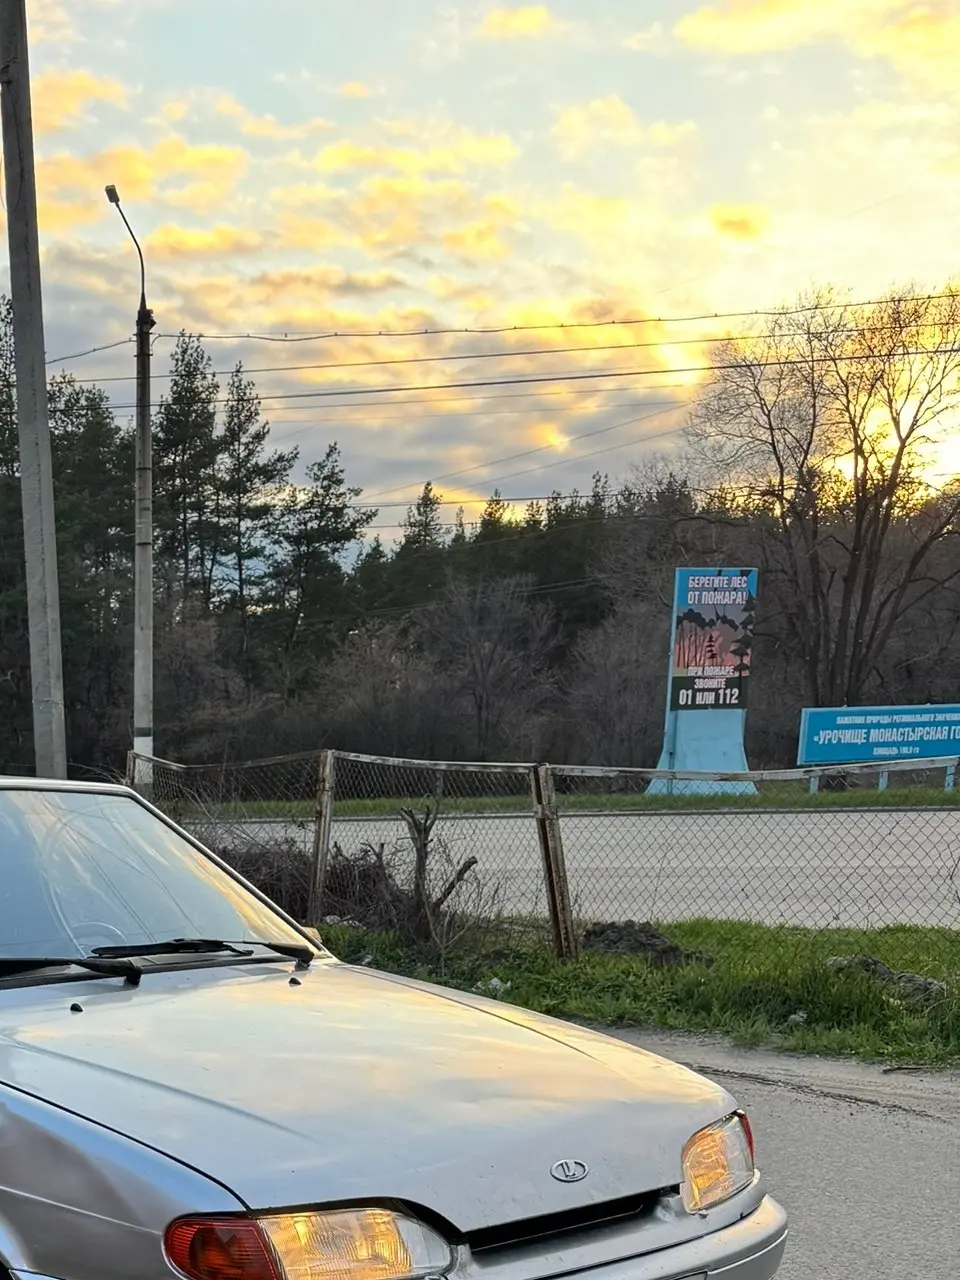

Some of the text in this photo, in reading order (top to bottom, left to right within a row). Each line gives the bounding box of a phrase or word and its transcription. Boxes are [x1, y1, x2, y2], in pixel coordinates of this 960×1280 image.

[688, 576, 748, 588] БЕРЕГИТЕ ЛЕС
[687, 591, 747, 604] ОТ ПОЖАРА!
[687, 665, 735, 676] ПРИ ПОЖАРЕ
[694, 678, 726, 689] ЗВОНИТЕ
[679, 689, 693, 705] 01
[718, 688, 739, 704] 112
[813, 729, 867, 744] «УРОЧИЩЕ
[869, 726, 948, 742] МОНАСТЫРСКАЯ
